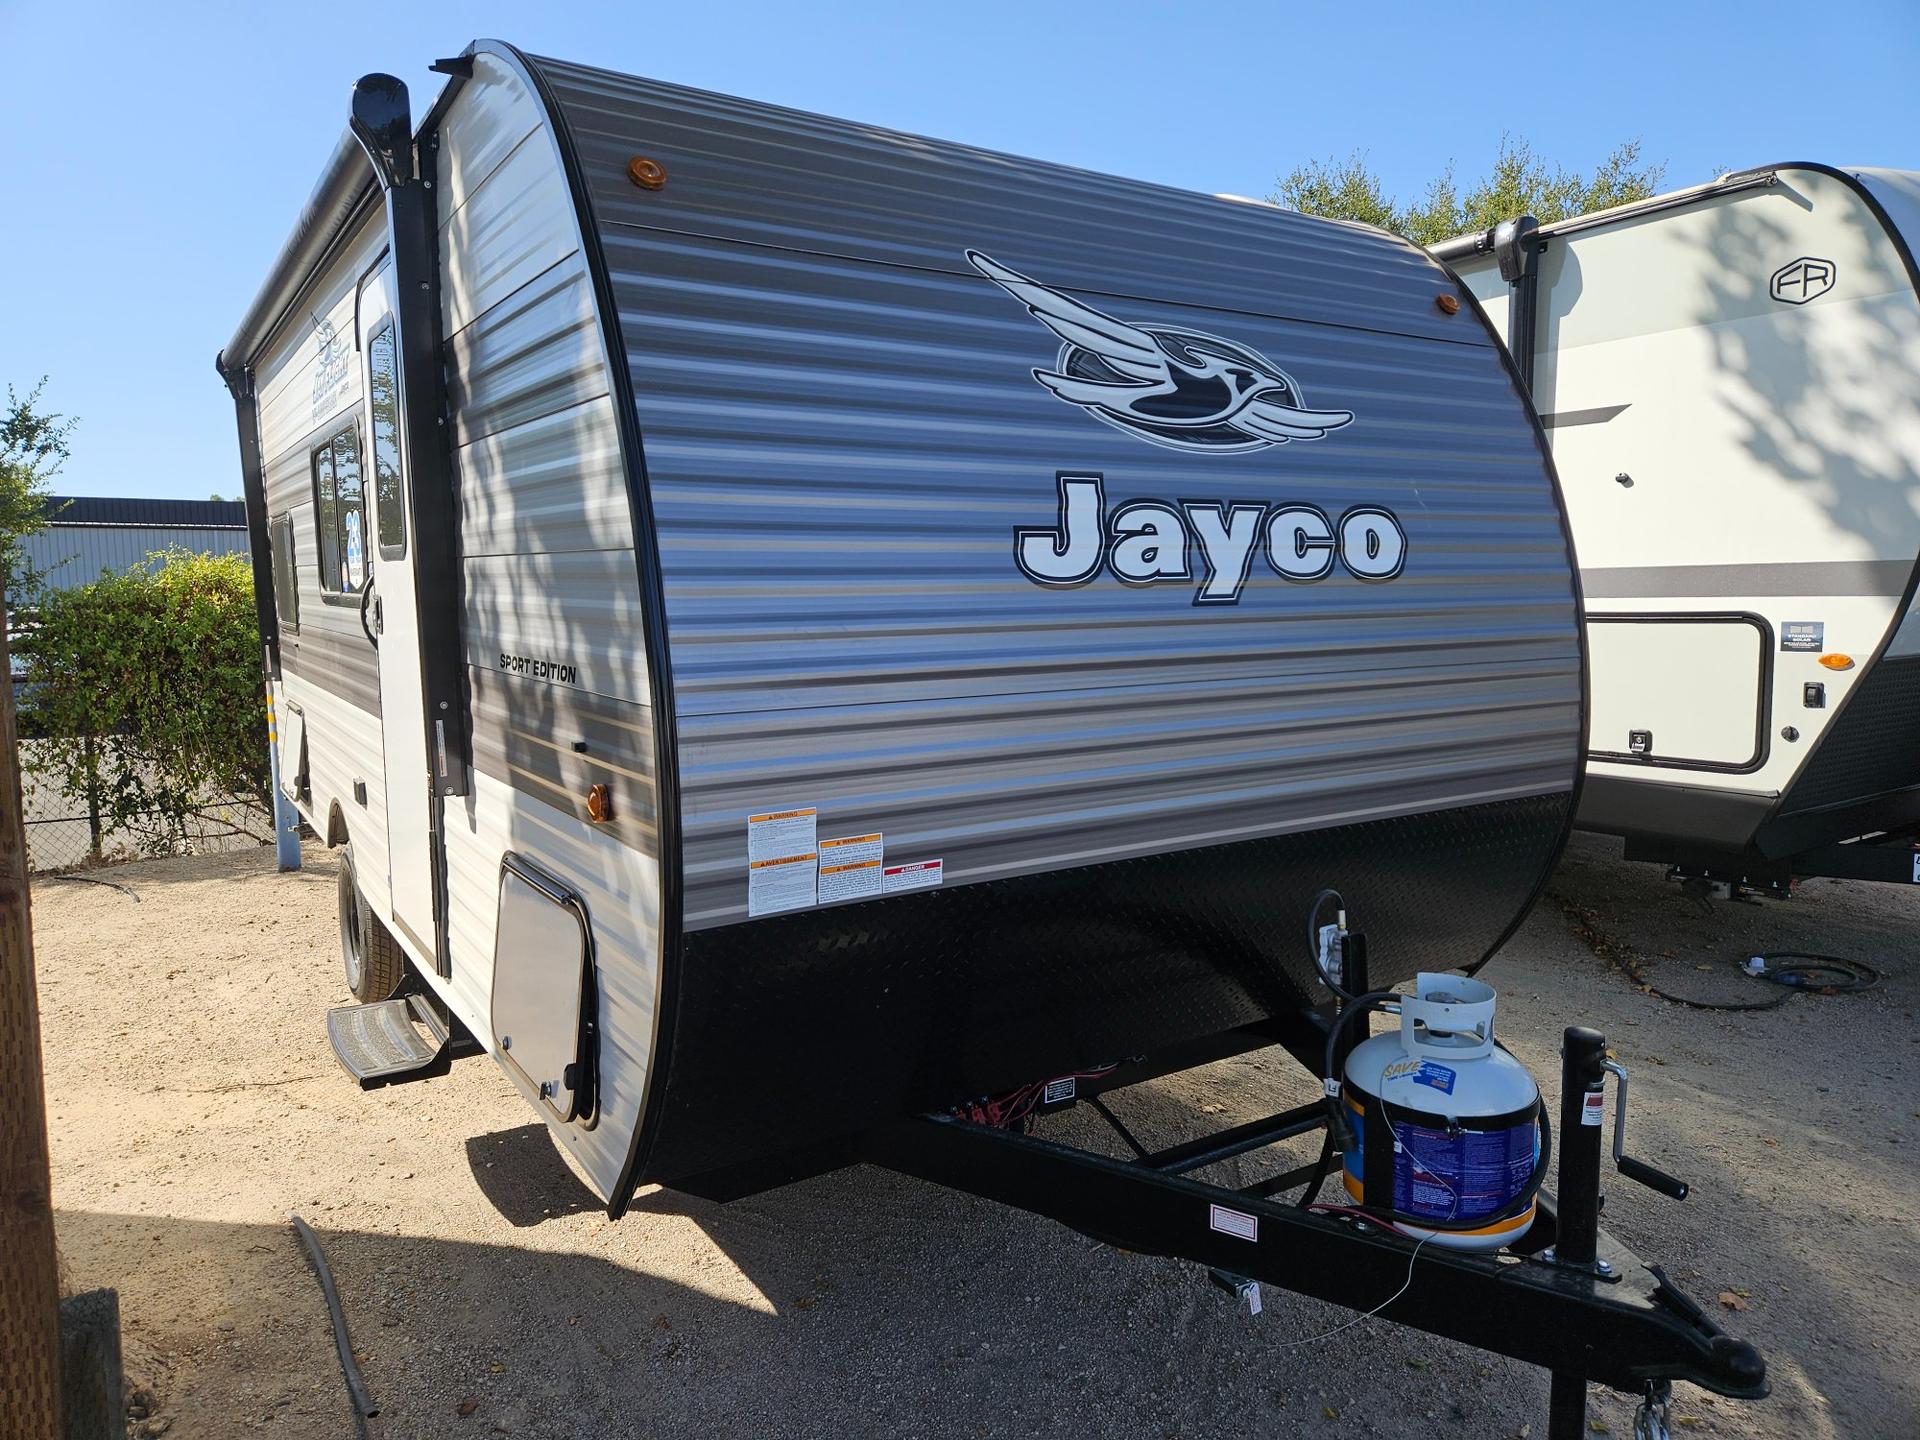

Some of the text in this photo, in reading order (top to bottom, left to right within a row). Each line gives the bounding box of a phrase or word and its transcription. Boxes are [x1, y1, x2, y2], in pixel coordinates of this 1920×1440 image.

[1013, 470, 1408, 606] Jayco
[500, 653, 577, 683] SPORT EDITION
